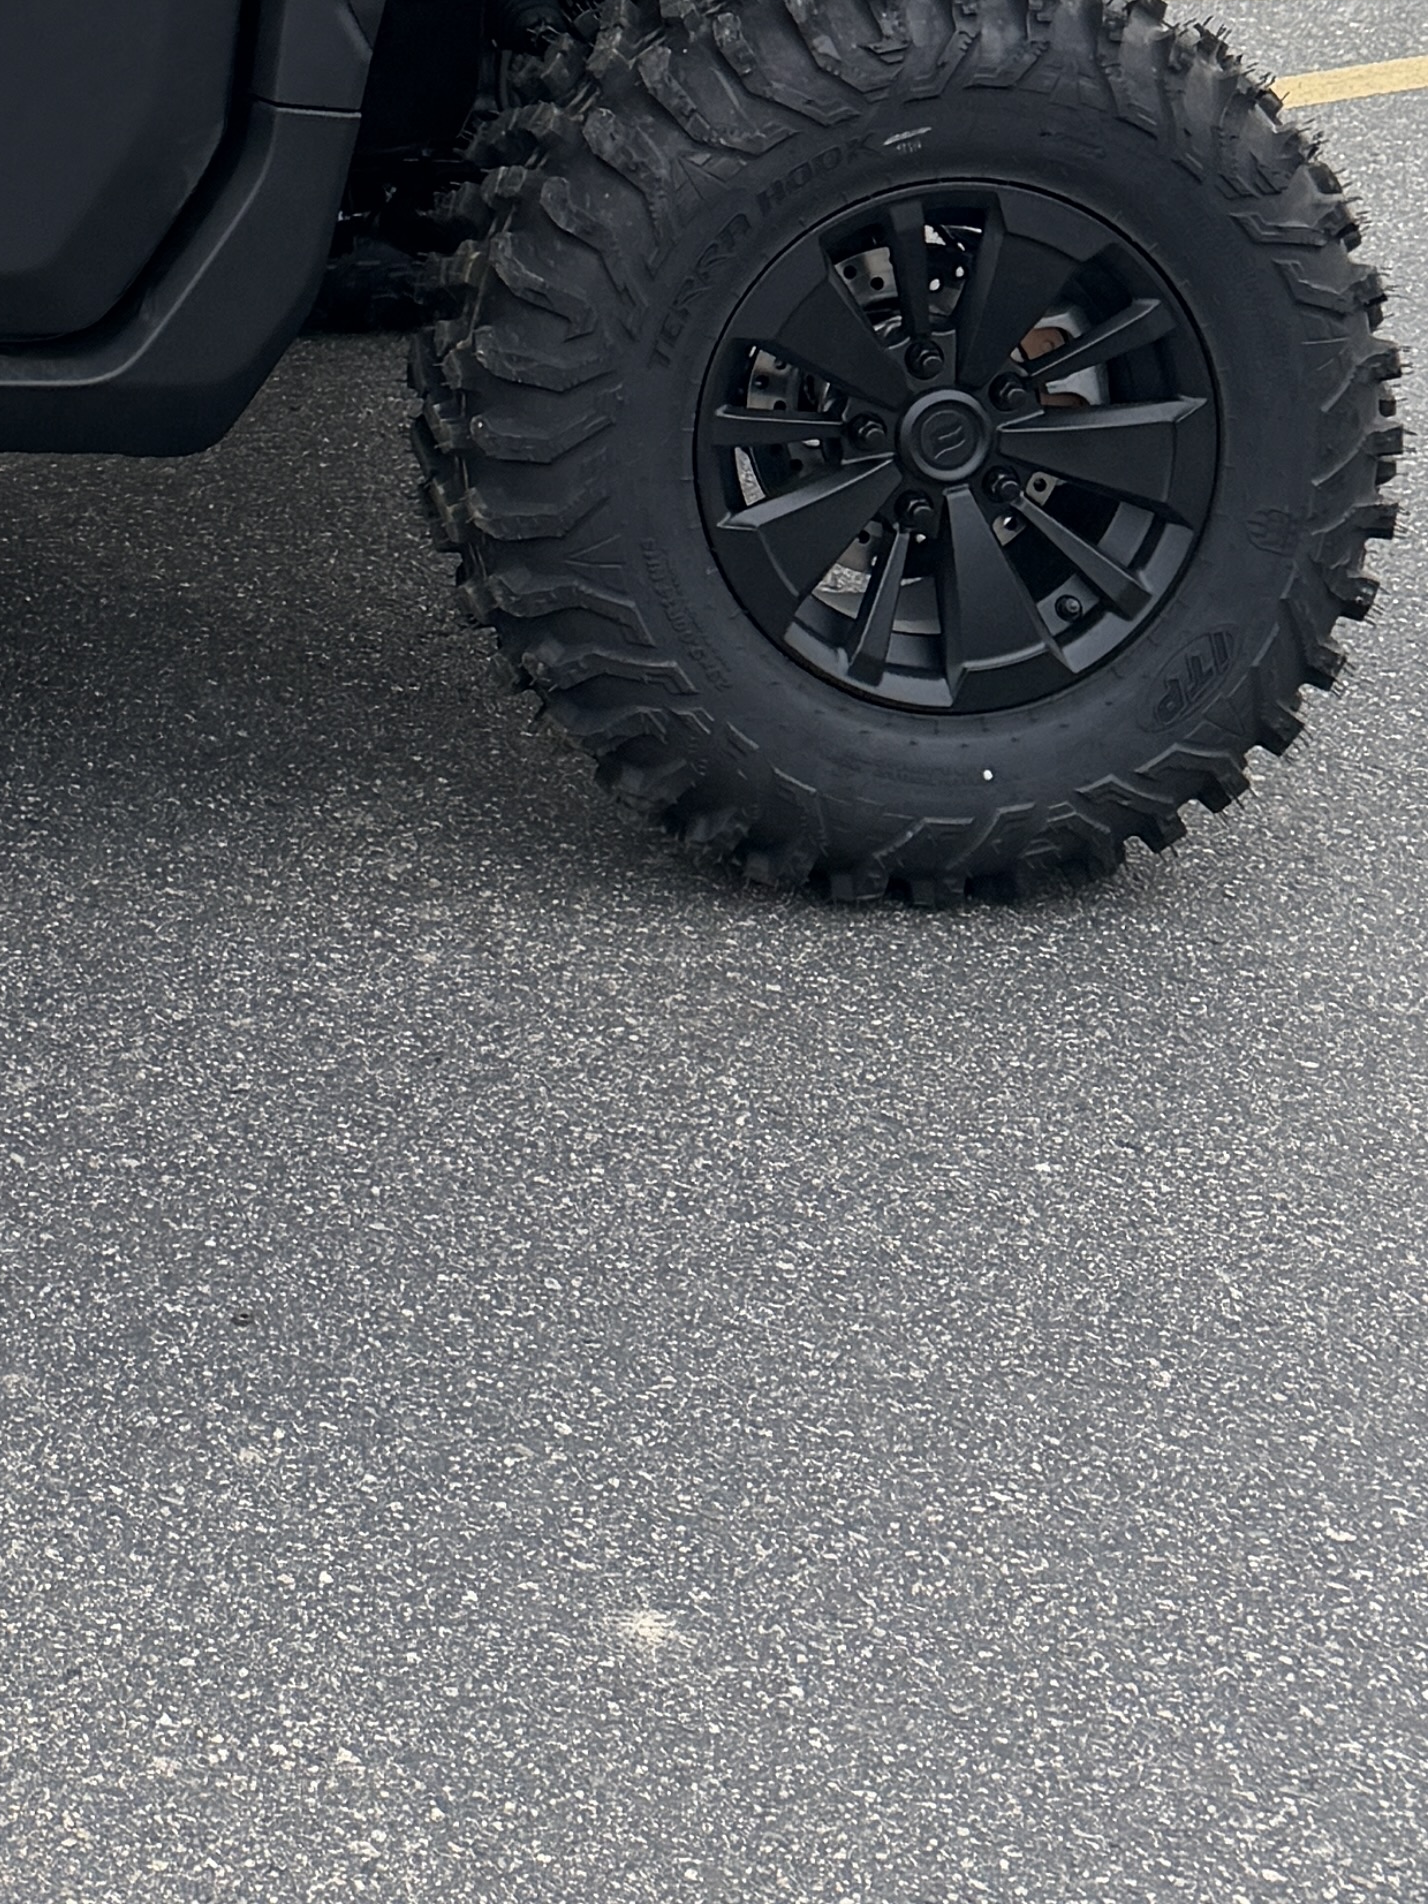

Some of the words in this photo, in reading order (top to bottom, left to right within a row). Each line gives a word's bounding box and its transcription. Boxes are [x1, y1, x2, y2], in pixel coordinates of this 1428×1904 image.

[645, 212, 752, 370] TERRA
[756, 132, 880, 217] HOOK
[1153, 630, 1236, 725] ITP
